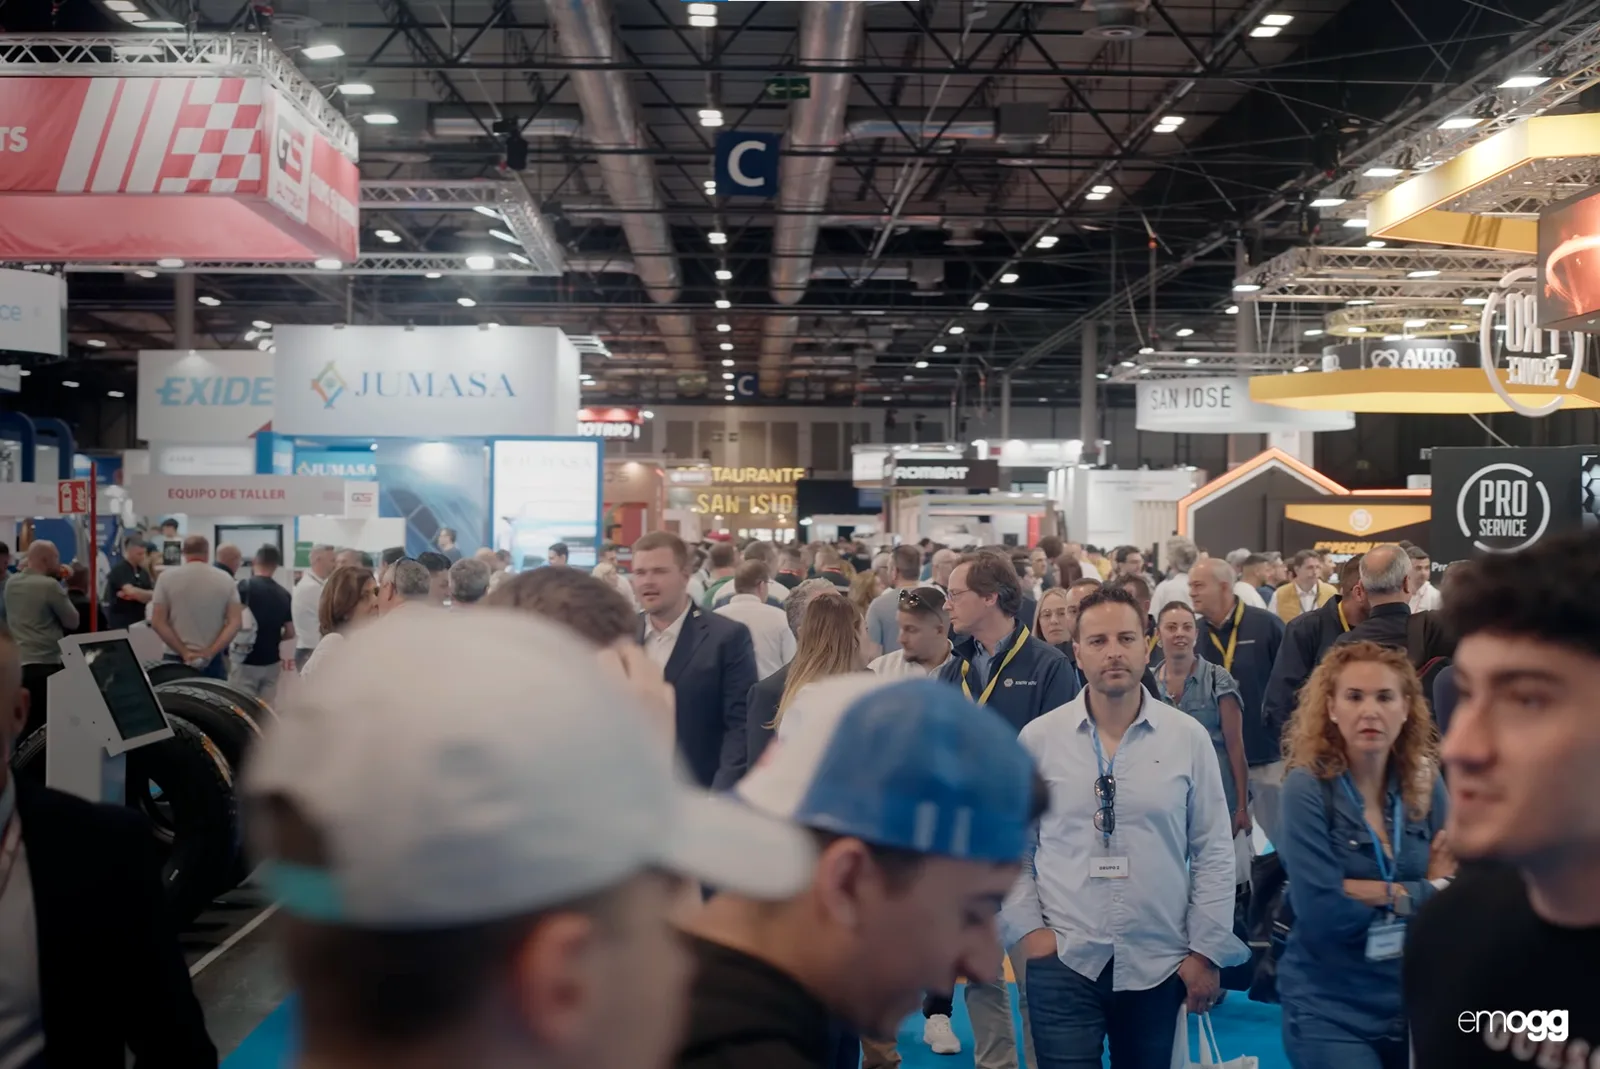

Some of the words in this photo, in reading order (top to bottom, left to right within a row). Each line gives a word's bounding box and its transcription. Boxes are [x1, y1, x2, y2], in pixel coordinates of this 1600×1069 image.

[727, 140, 766, 187] C
[156, 376, 274, 406] EXIDE
[354, 371, 517, 397] JUMASA
[737, 375, 755, 395] C
[1151, 389, 1178, 410] SAN
[1184, 385, 1233, 408] JOSÉ
[168, 488, 217, 500] EQUIPO
[220, 489, 238, 500] DE
[239, 489, 286, 500] TALLER
[697, 493, 740, 514] SAN
[1479, 480, 1528, 517] PRO
[1478, 519, 1528, 537] SERVICE
